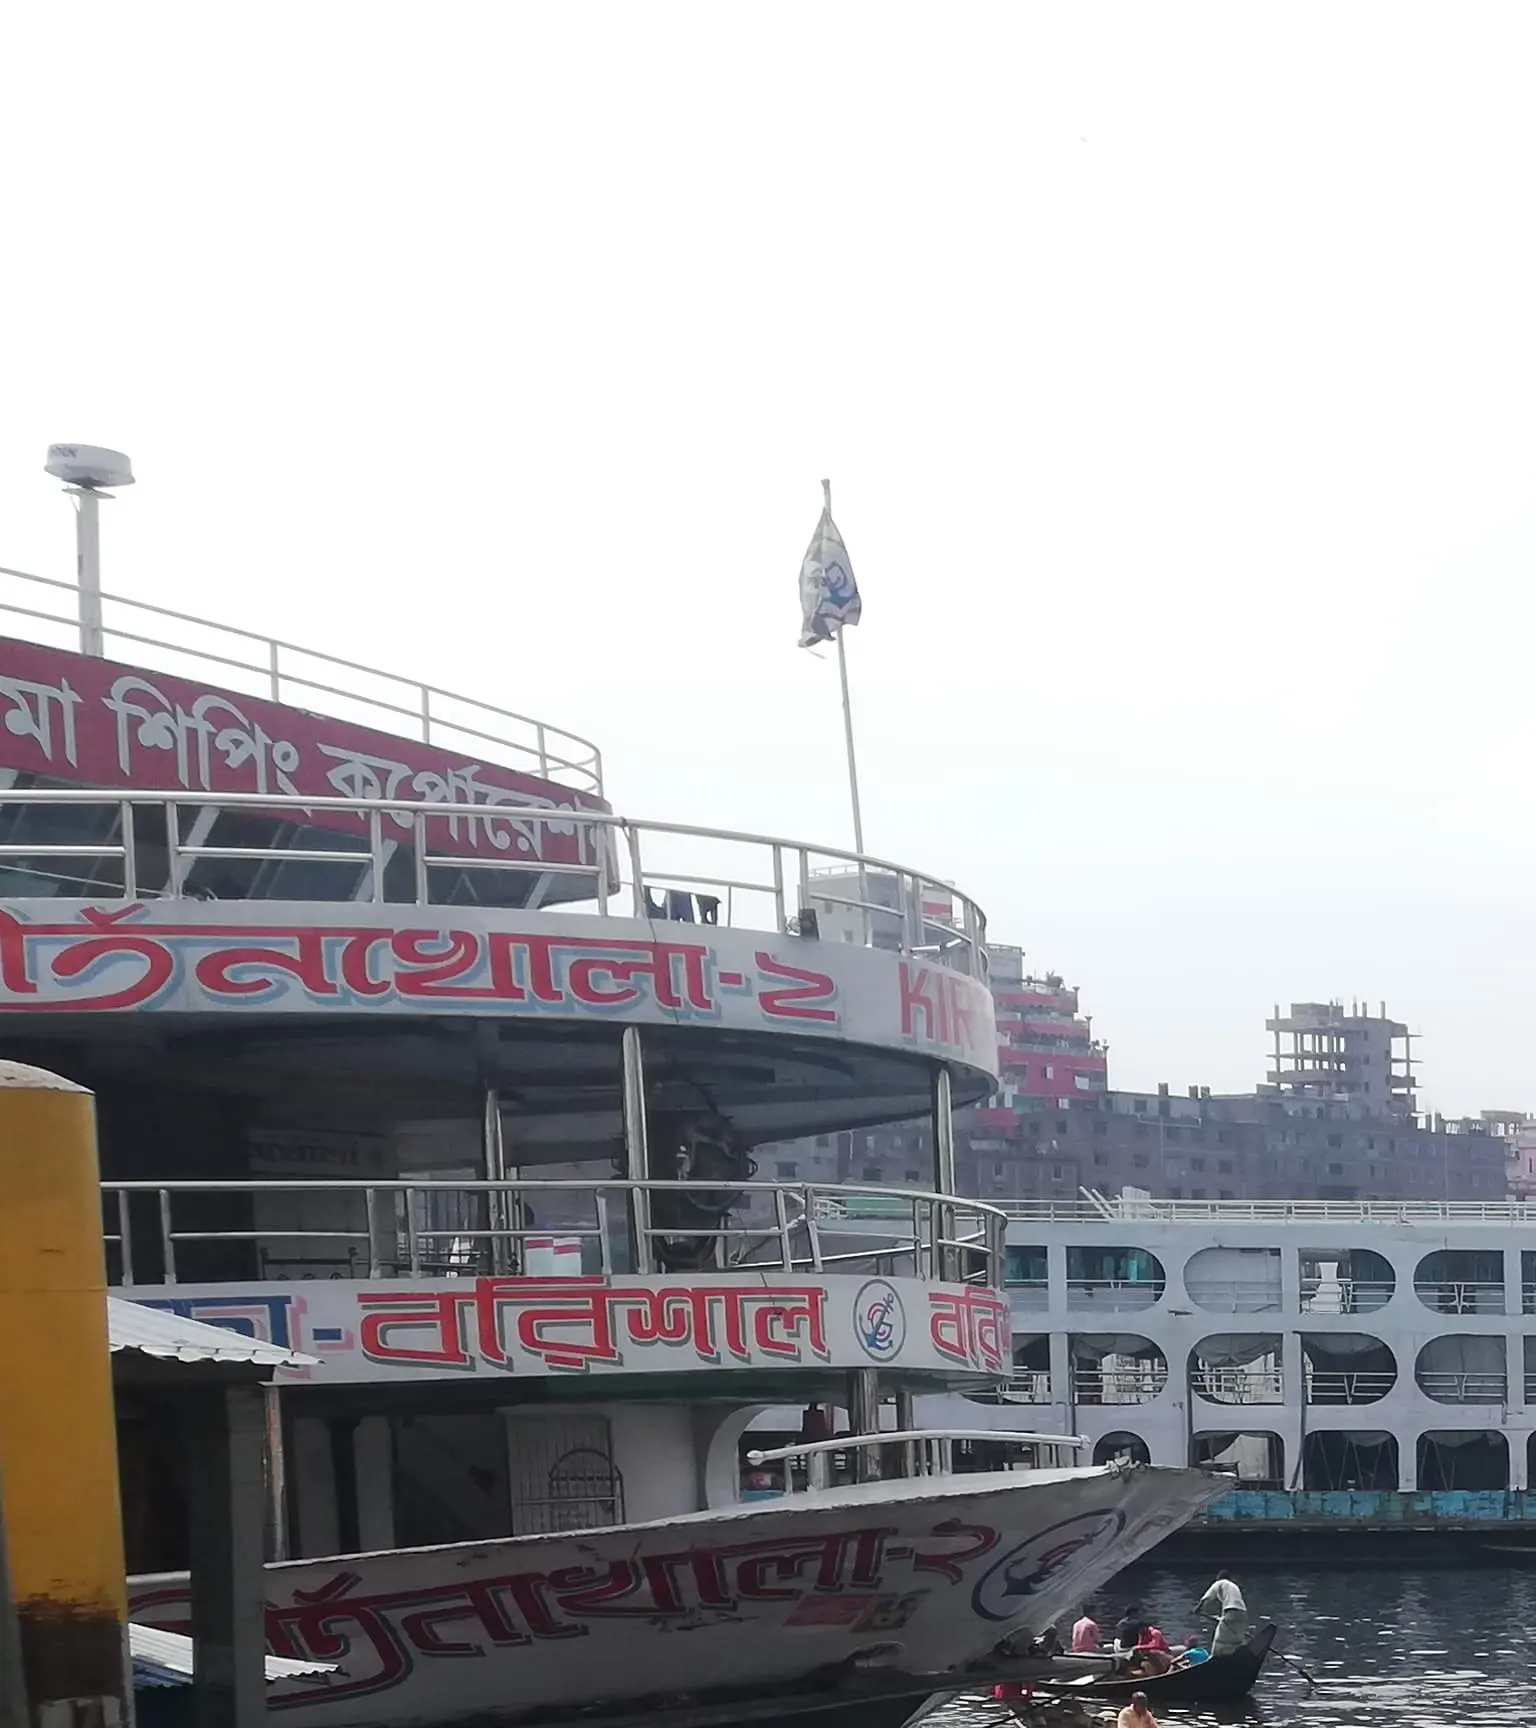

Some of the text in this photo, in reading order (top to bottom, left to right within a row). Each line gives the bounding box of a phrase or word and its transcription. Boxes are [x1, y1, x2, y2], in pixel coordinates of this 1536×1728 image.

[0, 676, 83, 768] মা
[101, 676, 310, 815] শিপিং
[928, 1286, 1011, 1370] বরি
